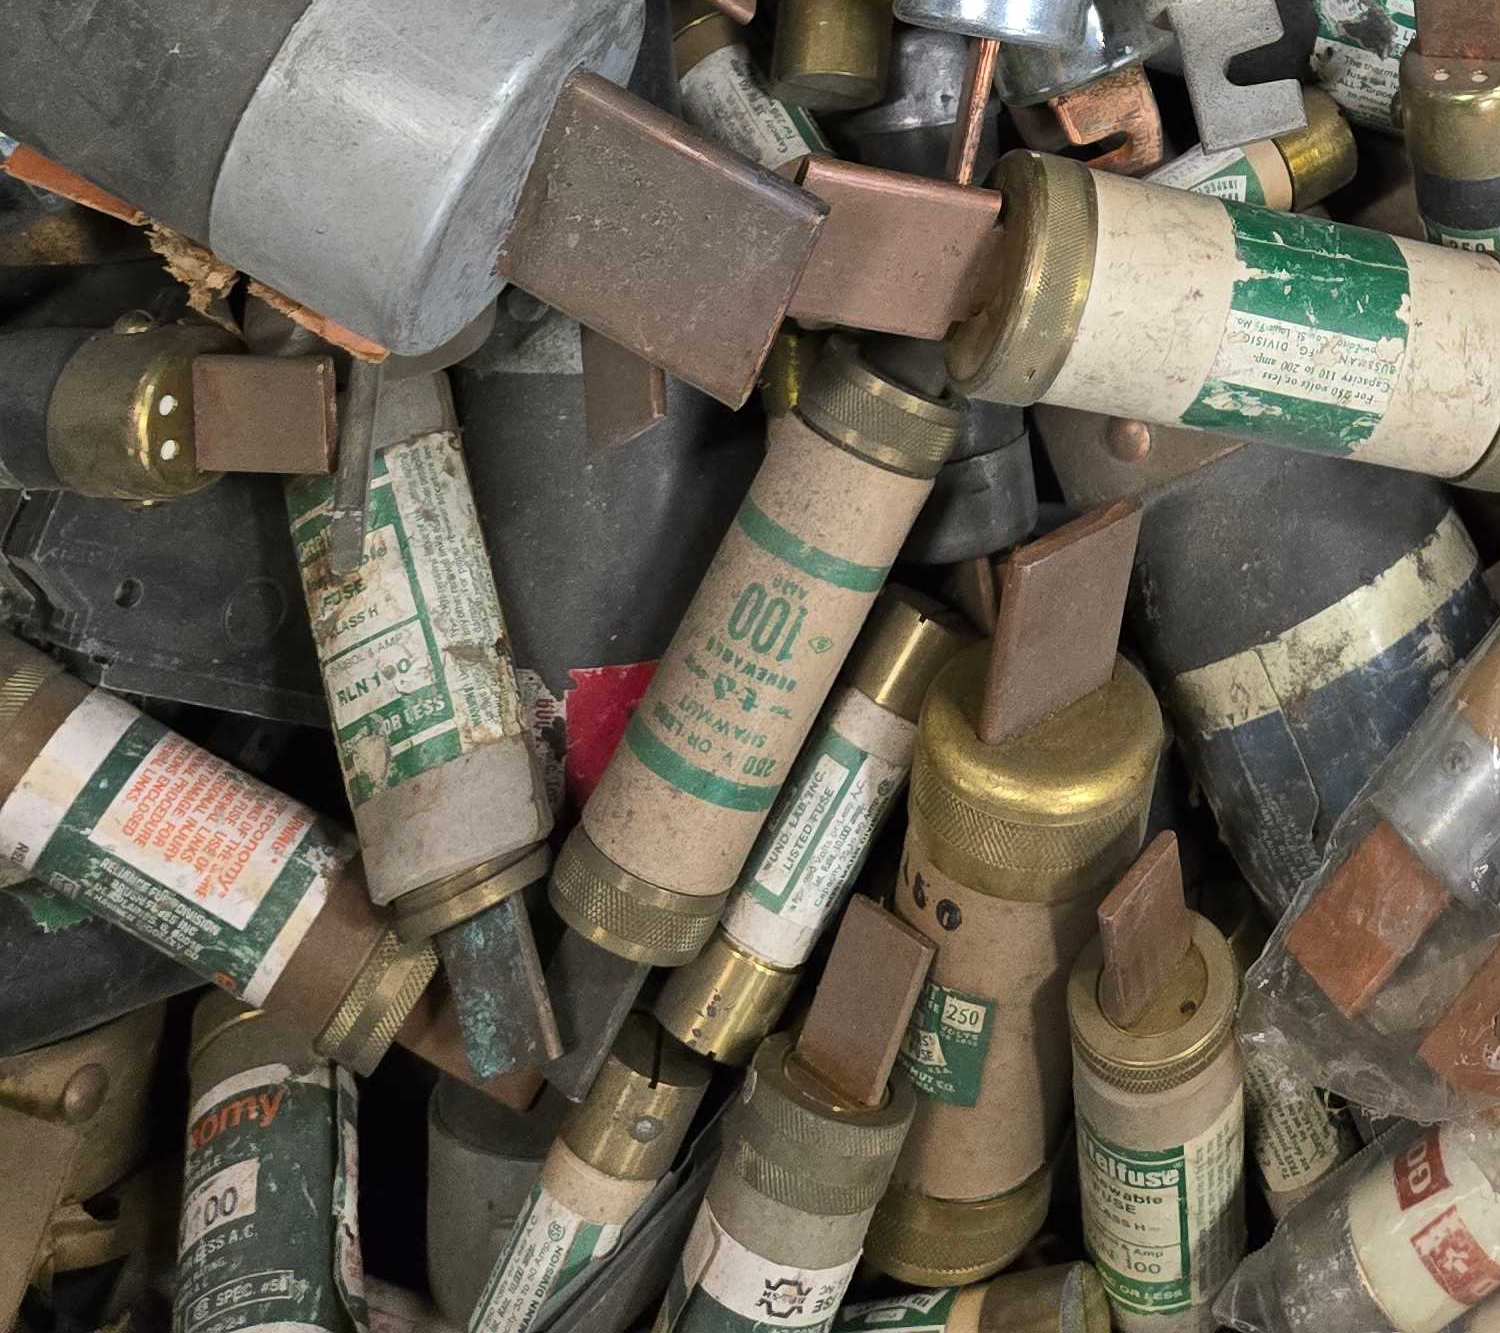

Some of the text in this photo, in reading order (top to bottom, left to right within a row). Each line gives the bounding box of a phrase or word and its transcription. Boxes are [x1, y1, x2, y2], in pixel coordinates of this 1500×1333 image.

[1251, 352, 1278, 367] amp.
[1280, 359, 1300, 373] 200
[1317, 367, 1337, 383] 110
[1260, 371, 1375, 404] For volts or less
[1339, 370, 1392, 393] Capacity
[720, 580, 812, 664] 100
[682, 729, 714, 755] OR
[118, 769, 172, 841] ENCLOSED
[120, 772, 152, 811] LINKS.
[130, 772, 187, 851] PROCEDURE
[149, 818, 177, 851] FOR
[158, 813, 199, 866] INJURY
[177, 822, 213, 866] LINKS
[780, 785, 837, 872] LISTED FUSE
[189, 852, 212, 877] OF
[944, 1001, 982, 1027] 250
[535, 1244, 563, 1298] DIVISION
